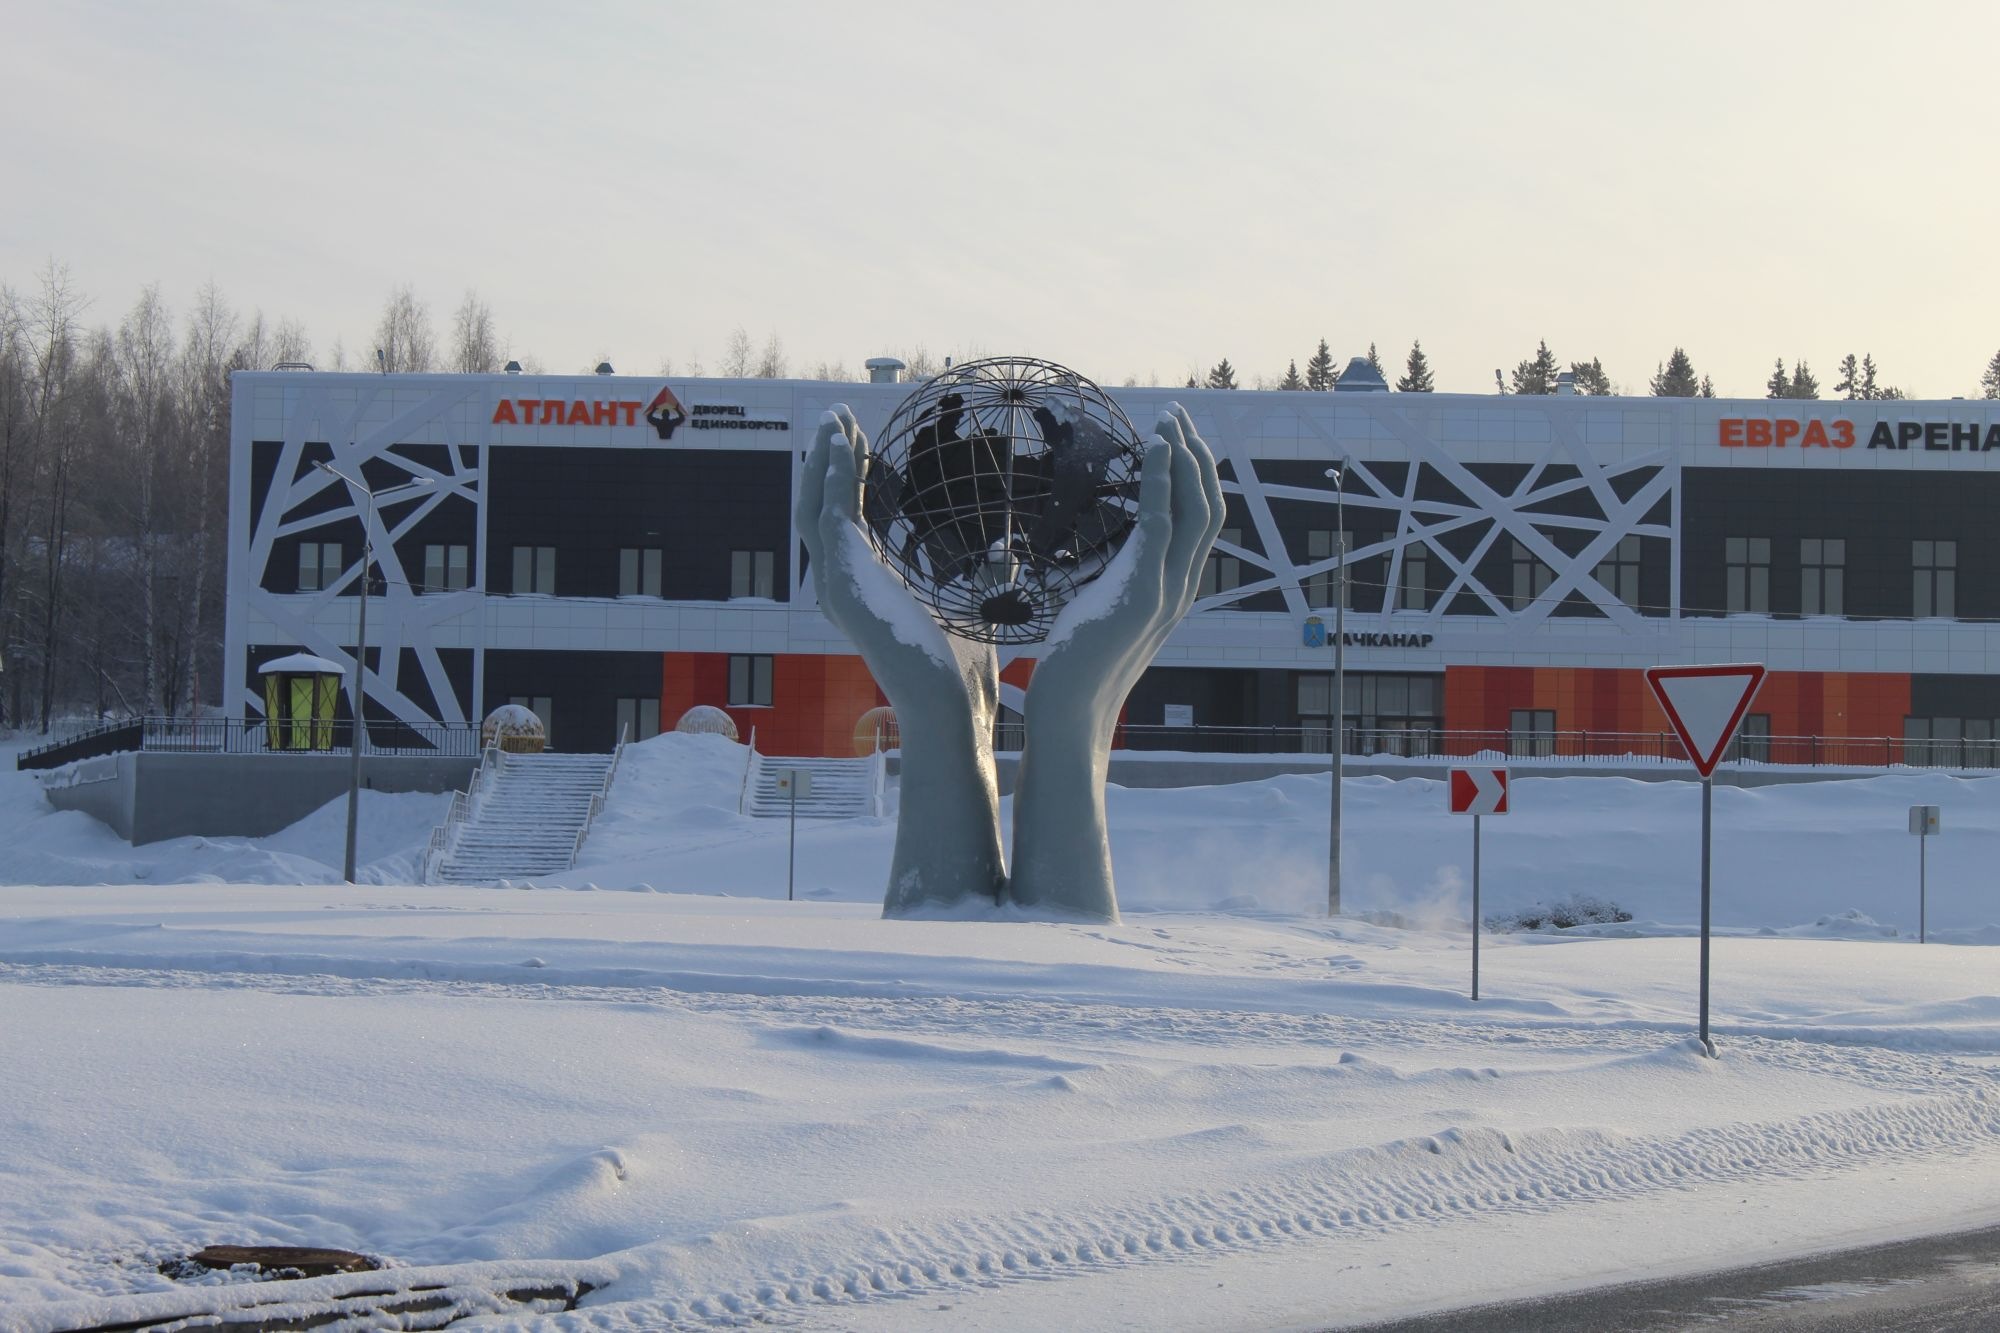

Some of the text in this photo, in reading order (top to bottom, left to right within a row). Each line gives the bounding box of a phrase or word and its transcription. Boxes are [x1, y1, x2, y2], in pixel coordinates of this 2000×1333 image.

[493, 399, 642, 426] АТЛАНТ
[692, 404, 746, 417] ДВОРЕЦ
[691, 419, 789, 431] ЕДИНОБОРСТВ
[1719, 418, 2000, 451] ЕВРАЗ АРЕНА
